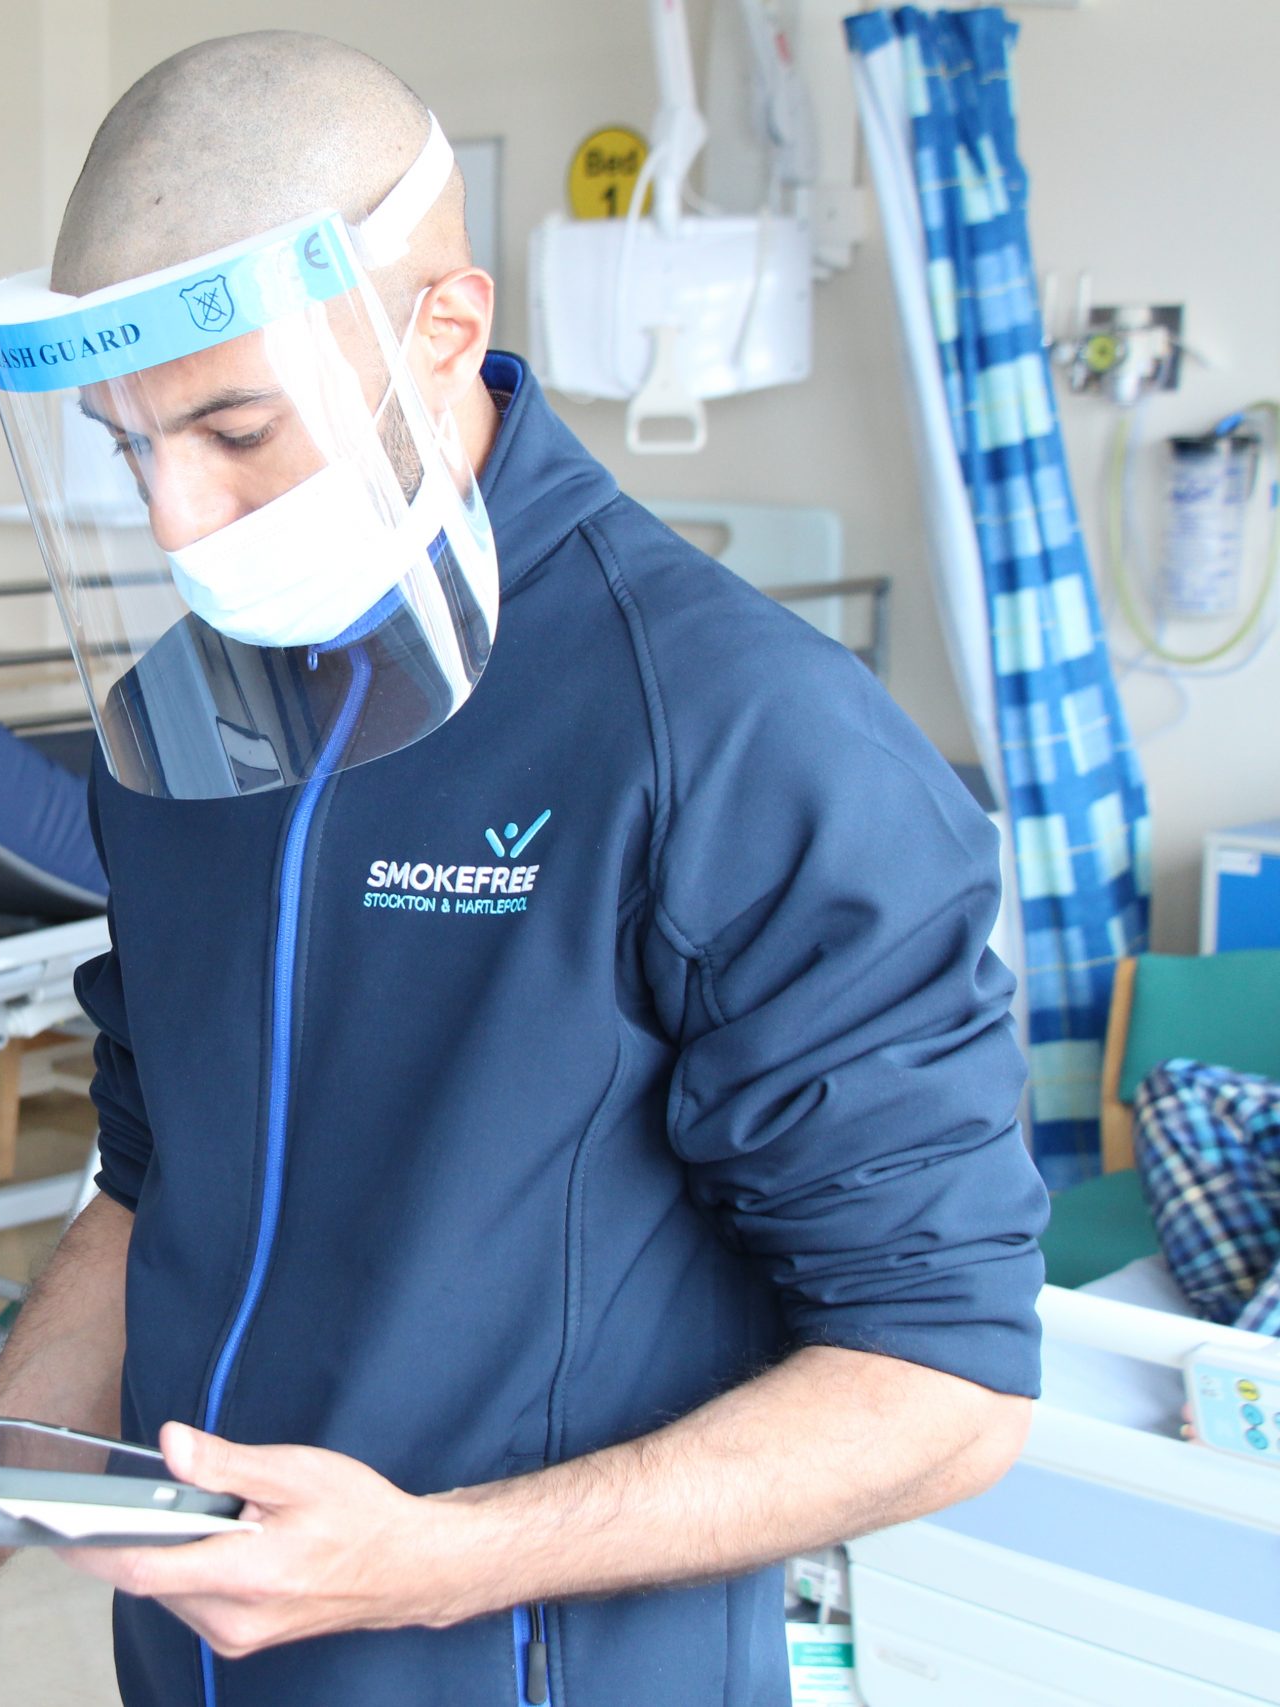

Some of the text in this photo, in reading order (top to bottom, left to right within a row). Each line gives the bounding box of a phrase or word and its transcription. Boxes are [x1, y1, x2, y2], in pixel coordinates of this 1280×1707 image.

[585, 148, 638, 176] Bed
[602, 185, 618, 217] 1
[367, 860, 540, 894] SMOKEFREE
[363, 892, 527, 914] STOCKTON & HARTLEPOOL
